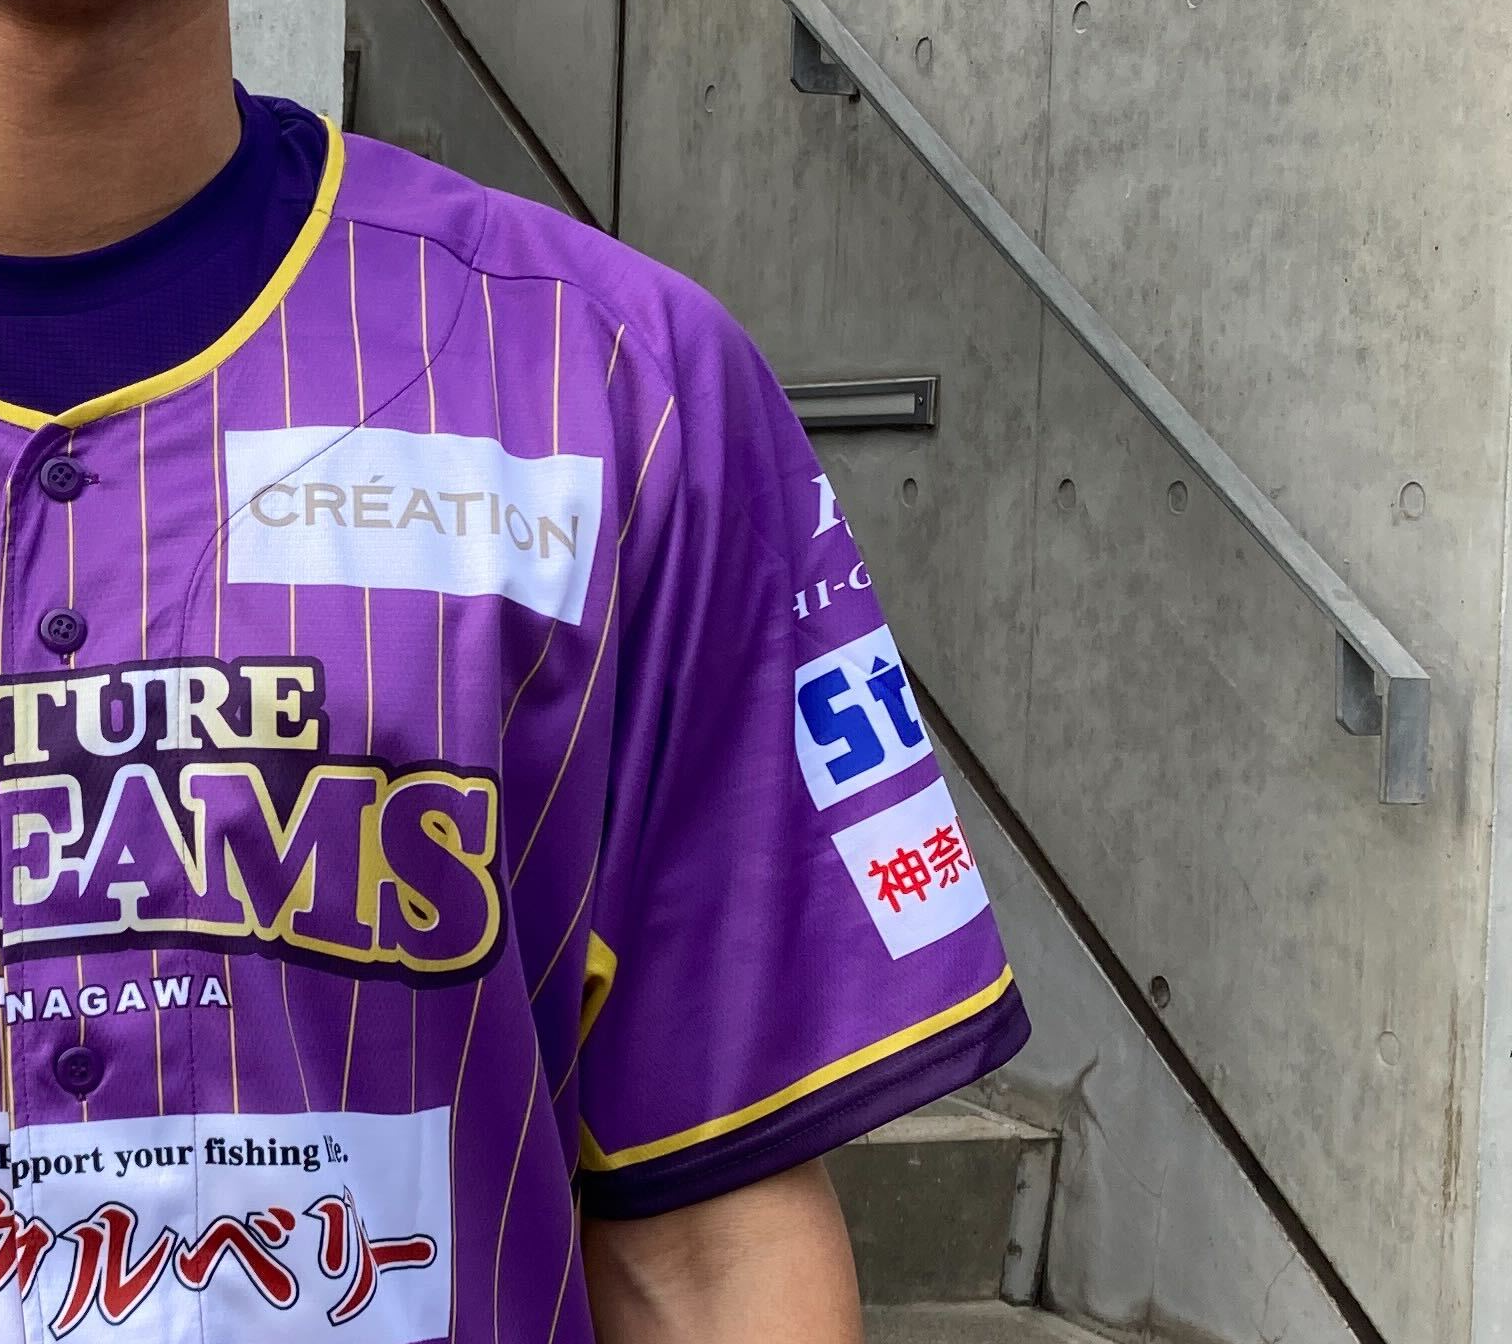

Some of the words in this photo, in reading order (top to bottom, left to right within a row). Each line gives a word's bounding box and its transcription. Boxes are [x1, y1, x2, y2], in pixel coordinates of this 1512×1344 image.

[248, 475, 579, 560] CRÉATION
[114, 1144, 194, 1178] your
[204, 1136, 321, 1172] fishing
